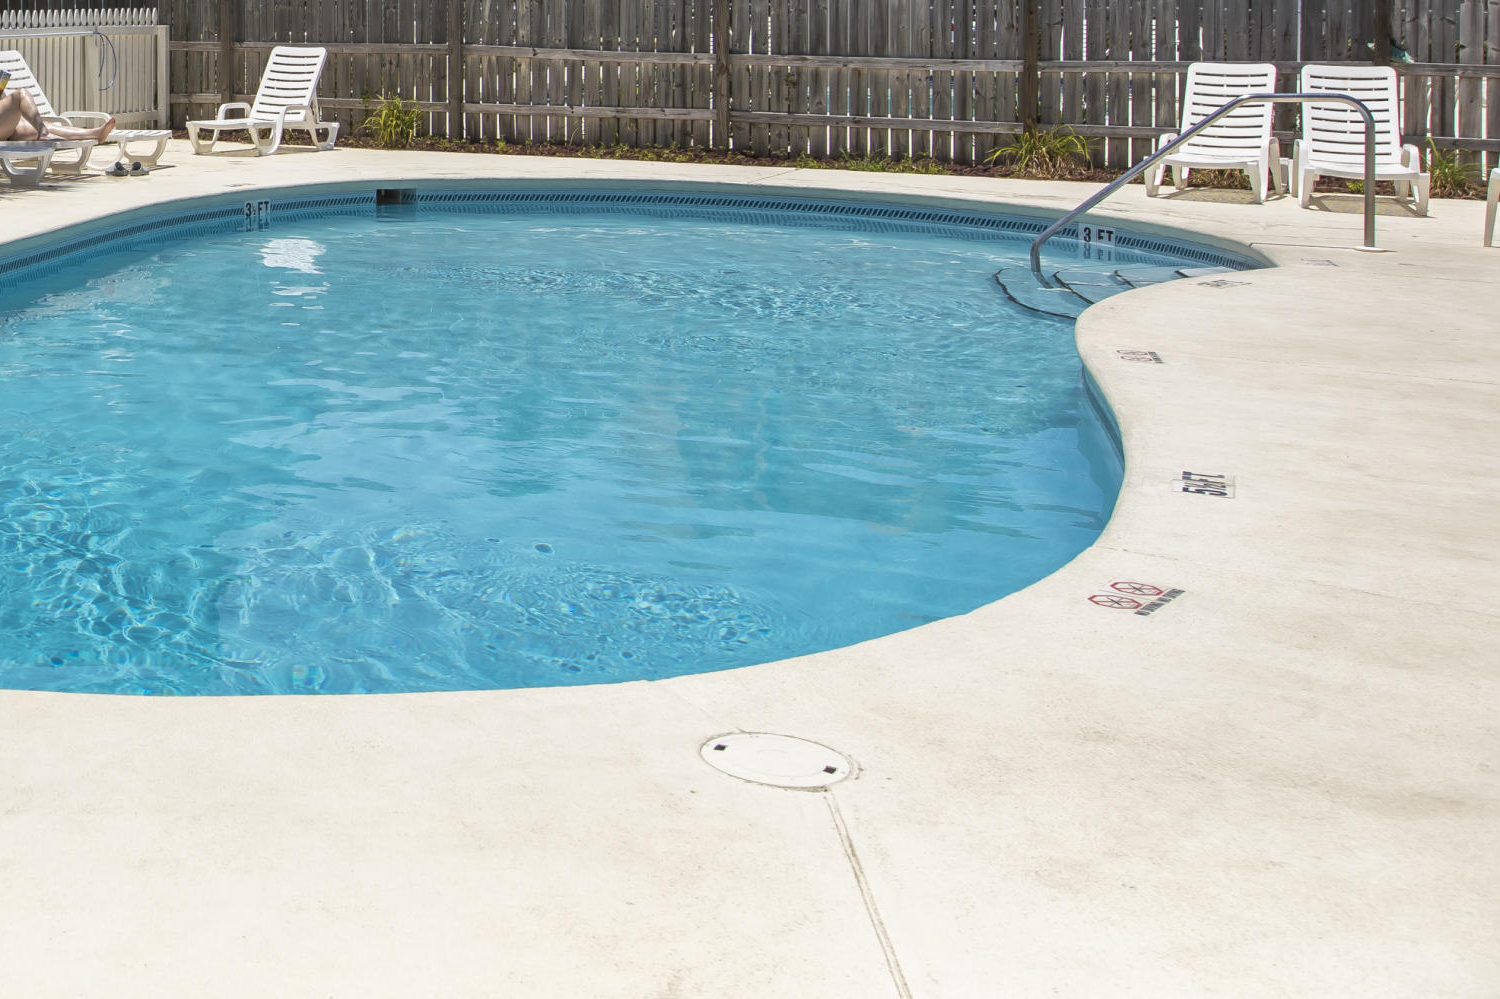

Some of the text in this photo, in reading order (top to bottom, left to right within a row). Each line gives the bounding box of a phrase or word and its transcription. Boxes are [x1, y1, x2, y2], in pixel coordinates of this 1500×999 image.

[258, 201, 270, 216] FT
[1083, 227, 1113, 242] 3 FT
